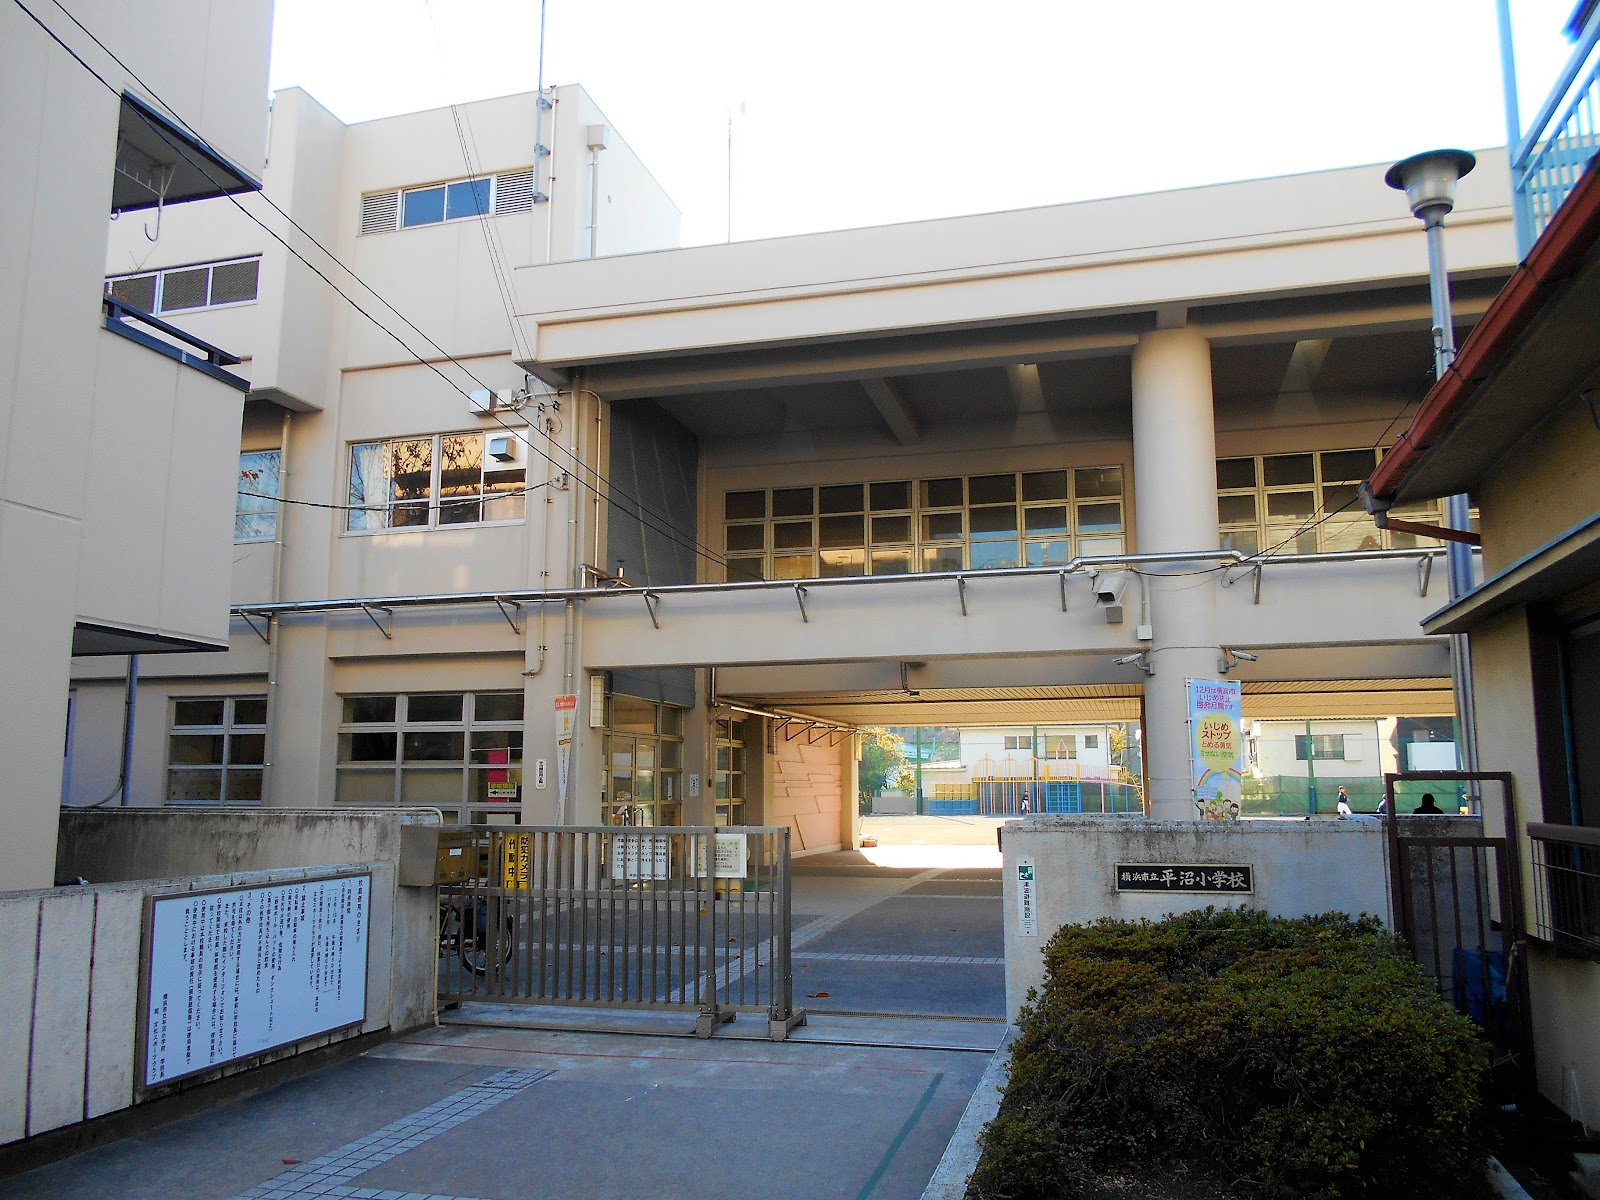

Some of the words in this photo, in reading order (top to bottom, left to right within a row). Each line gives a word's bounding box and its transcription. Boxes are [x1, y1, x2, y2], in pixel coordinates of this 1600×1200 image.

[1196, 686, 1236, 695] 12月は横浜市
[1197, 701, 1233, 710] 啓発月間です
[1203, 722, 1229, 731] いじめ
[1202, 731, 1231, 740] ストップ
[1202, 741, 1232, 750] とめる勇気
[1201, 750, 1234, 758] させない空気
[1121, 868, 1248, 888] 横浜市立平沼小学校
[1023, 881, 1031, 919] 津波避難施設
